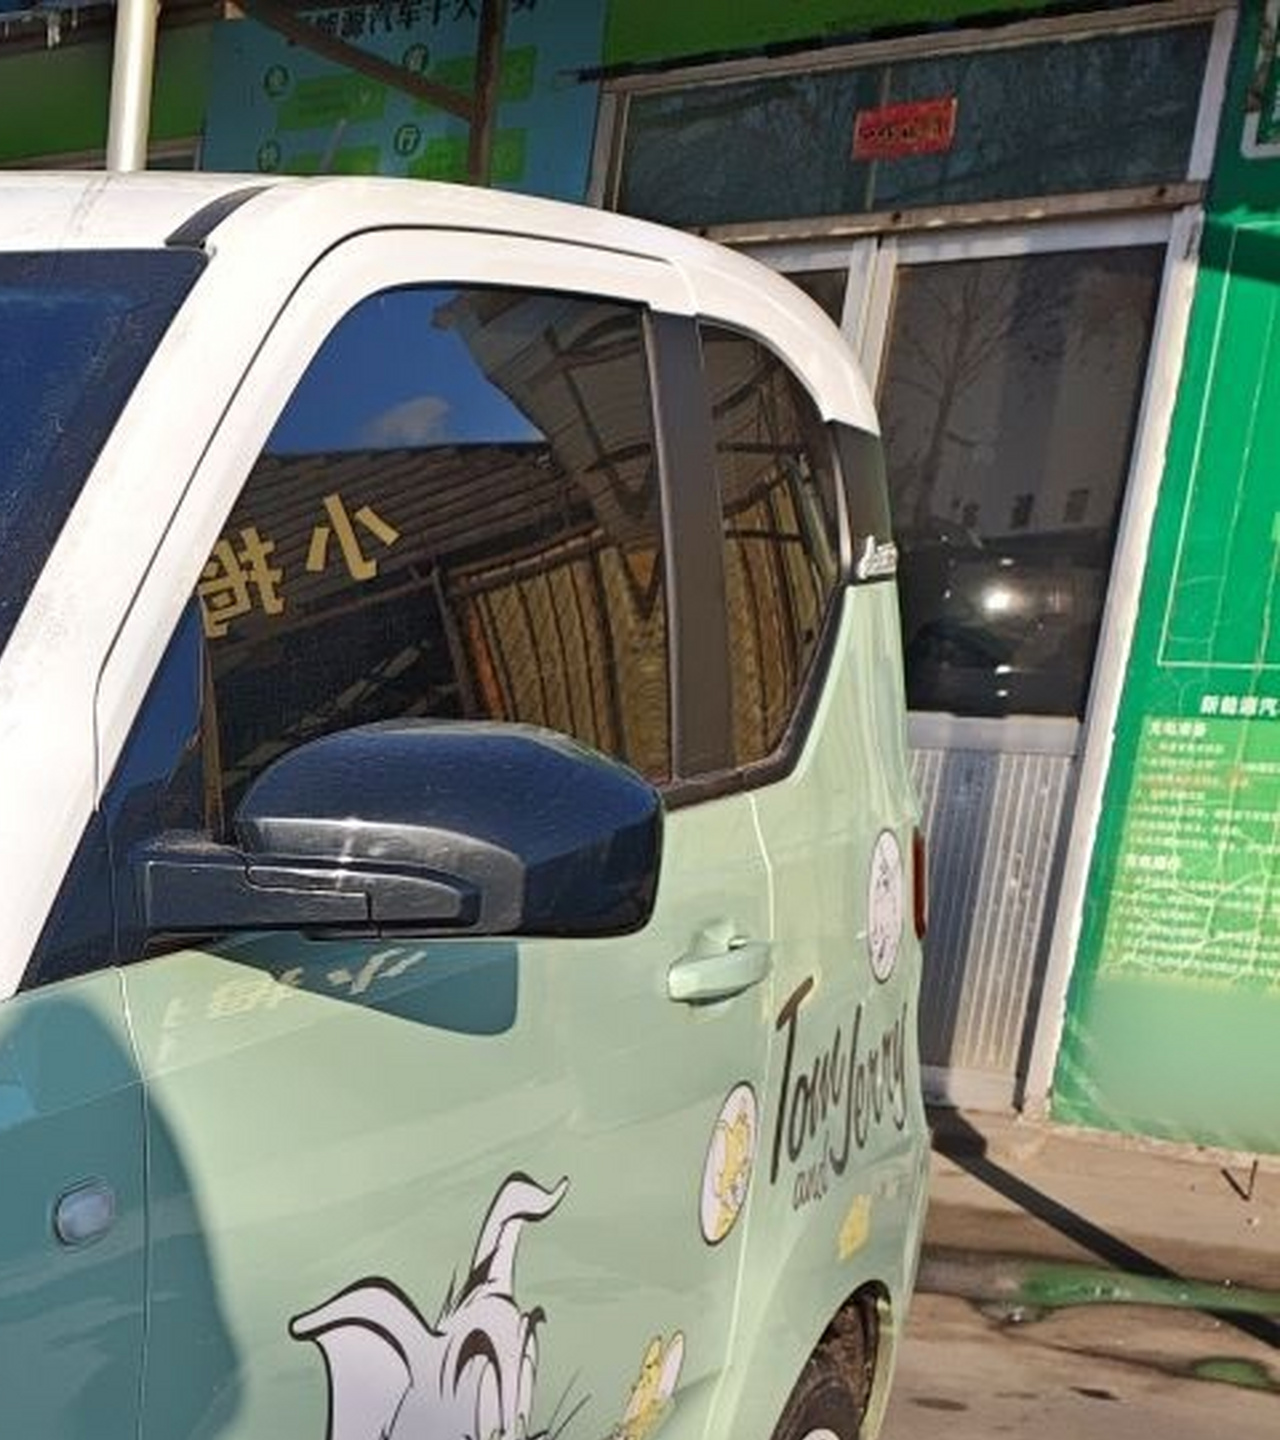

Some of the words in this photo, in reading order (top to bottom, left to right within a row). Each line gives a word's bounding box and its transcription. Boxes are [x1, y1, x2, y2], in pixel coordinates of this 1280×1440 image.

[1200, 694, 1280, 718] 新能源汽
[830, 1002, 907, 1175] Jerry
[793, 1131, 830, 1210] and
